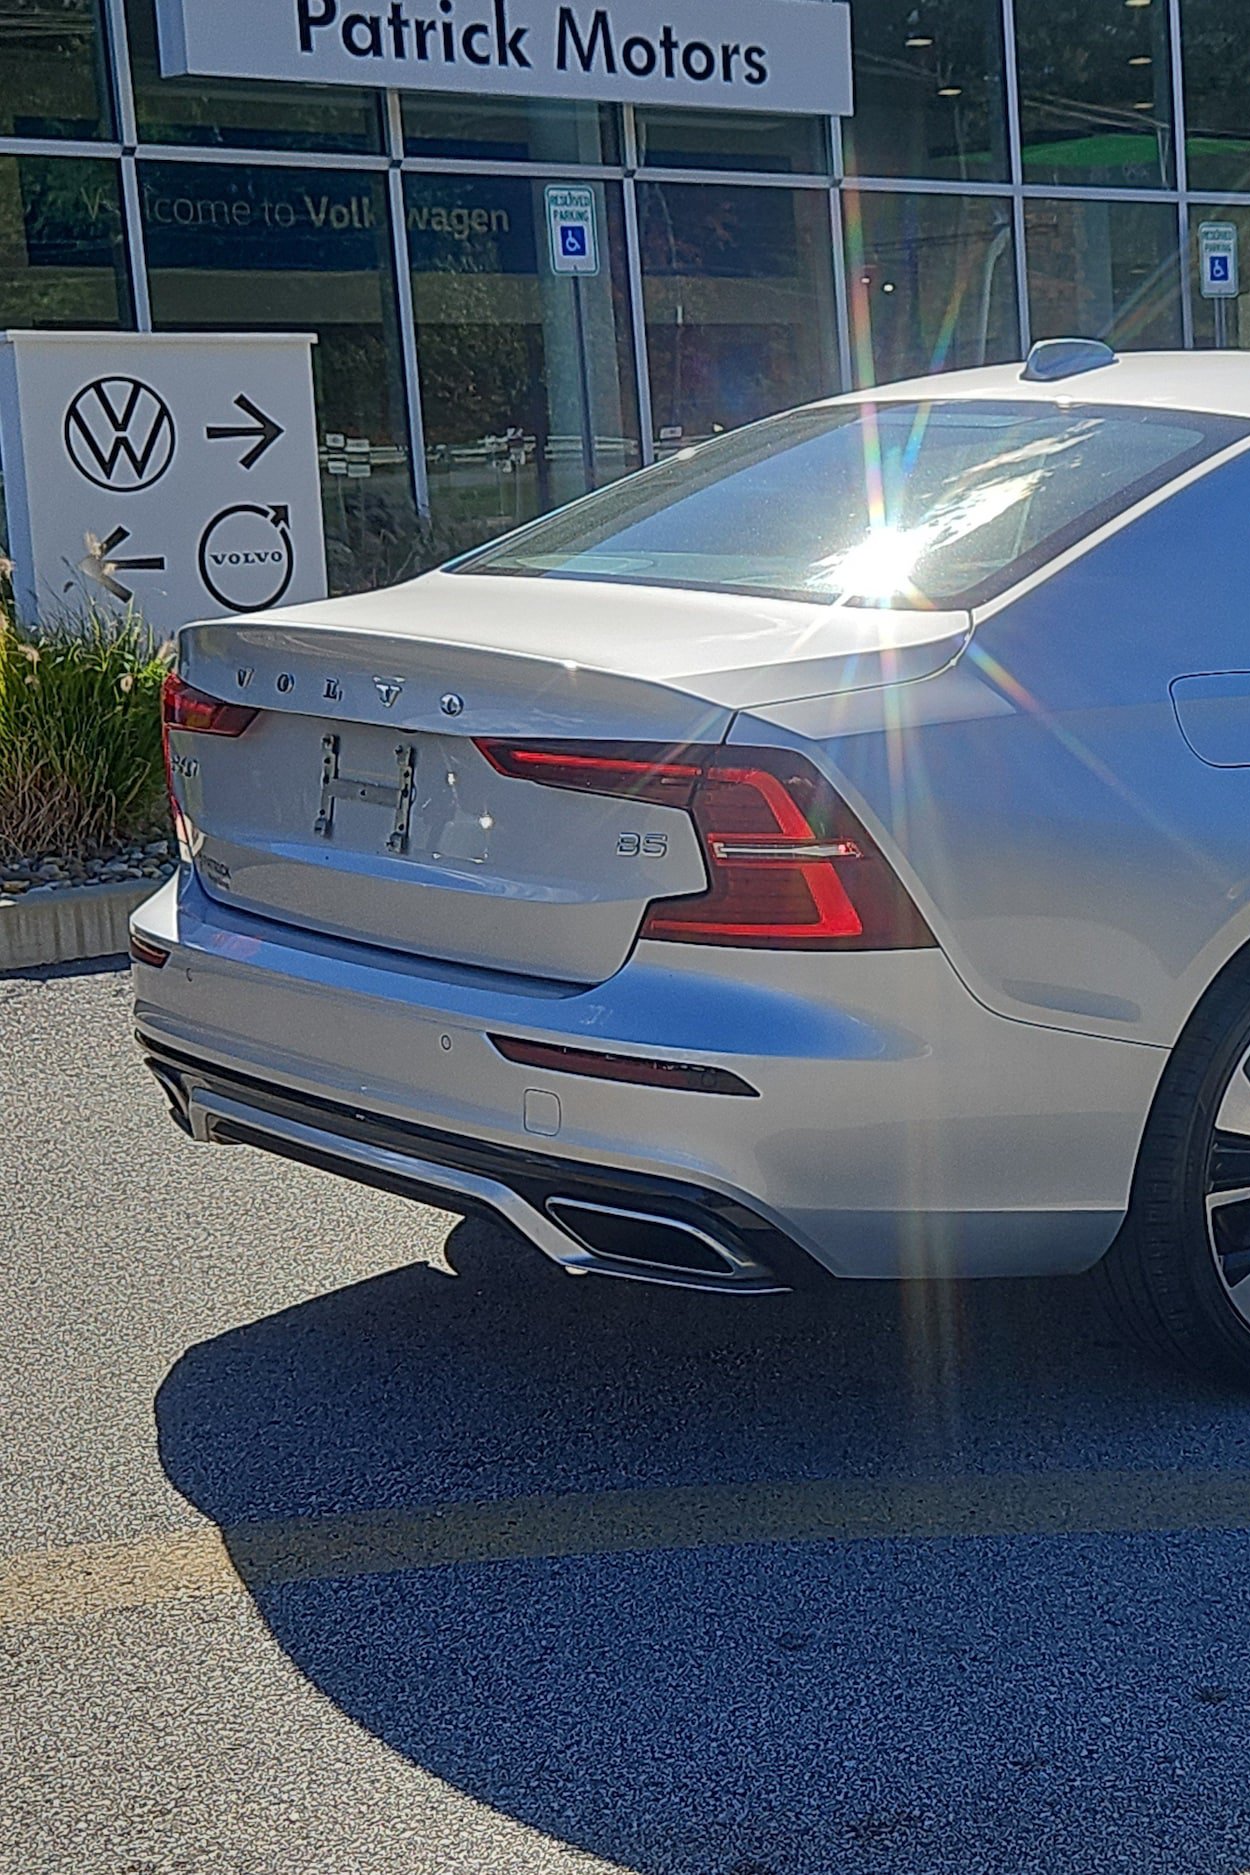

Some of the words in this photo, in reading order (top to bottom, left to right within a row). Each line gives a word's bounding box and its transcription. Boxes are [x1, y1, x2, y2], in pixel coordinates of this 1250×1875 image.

[299, 0, 532, 68] Patrick
[556, 7, 769, 86] Motors
[263, 197, 296, 229] to
[209, 550, 284, 566] VOLVO
[236, 667, 464, 718] VOLVO
